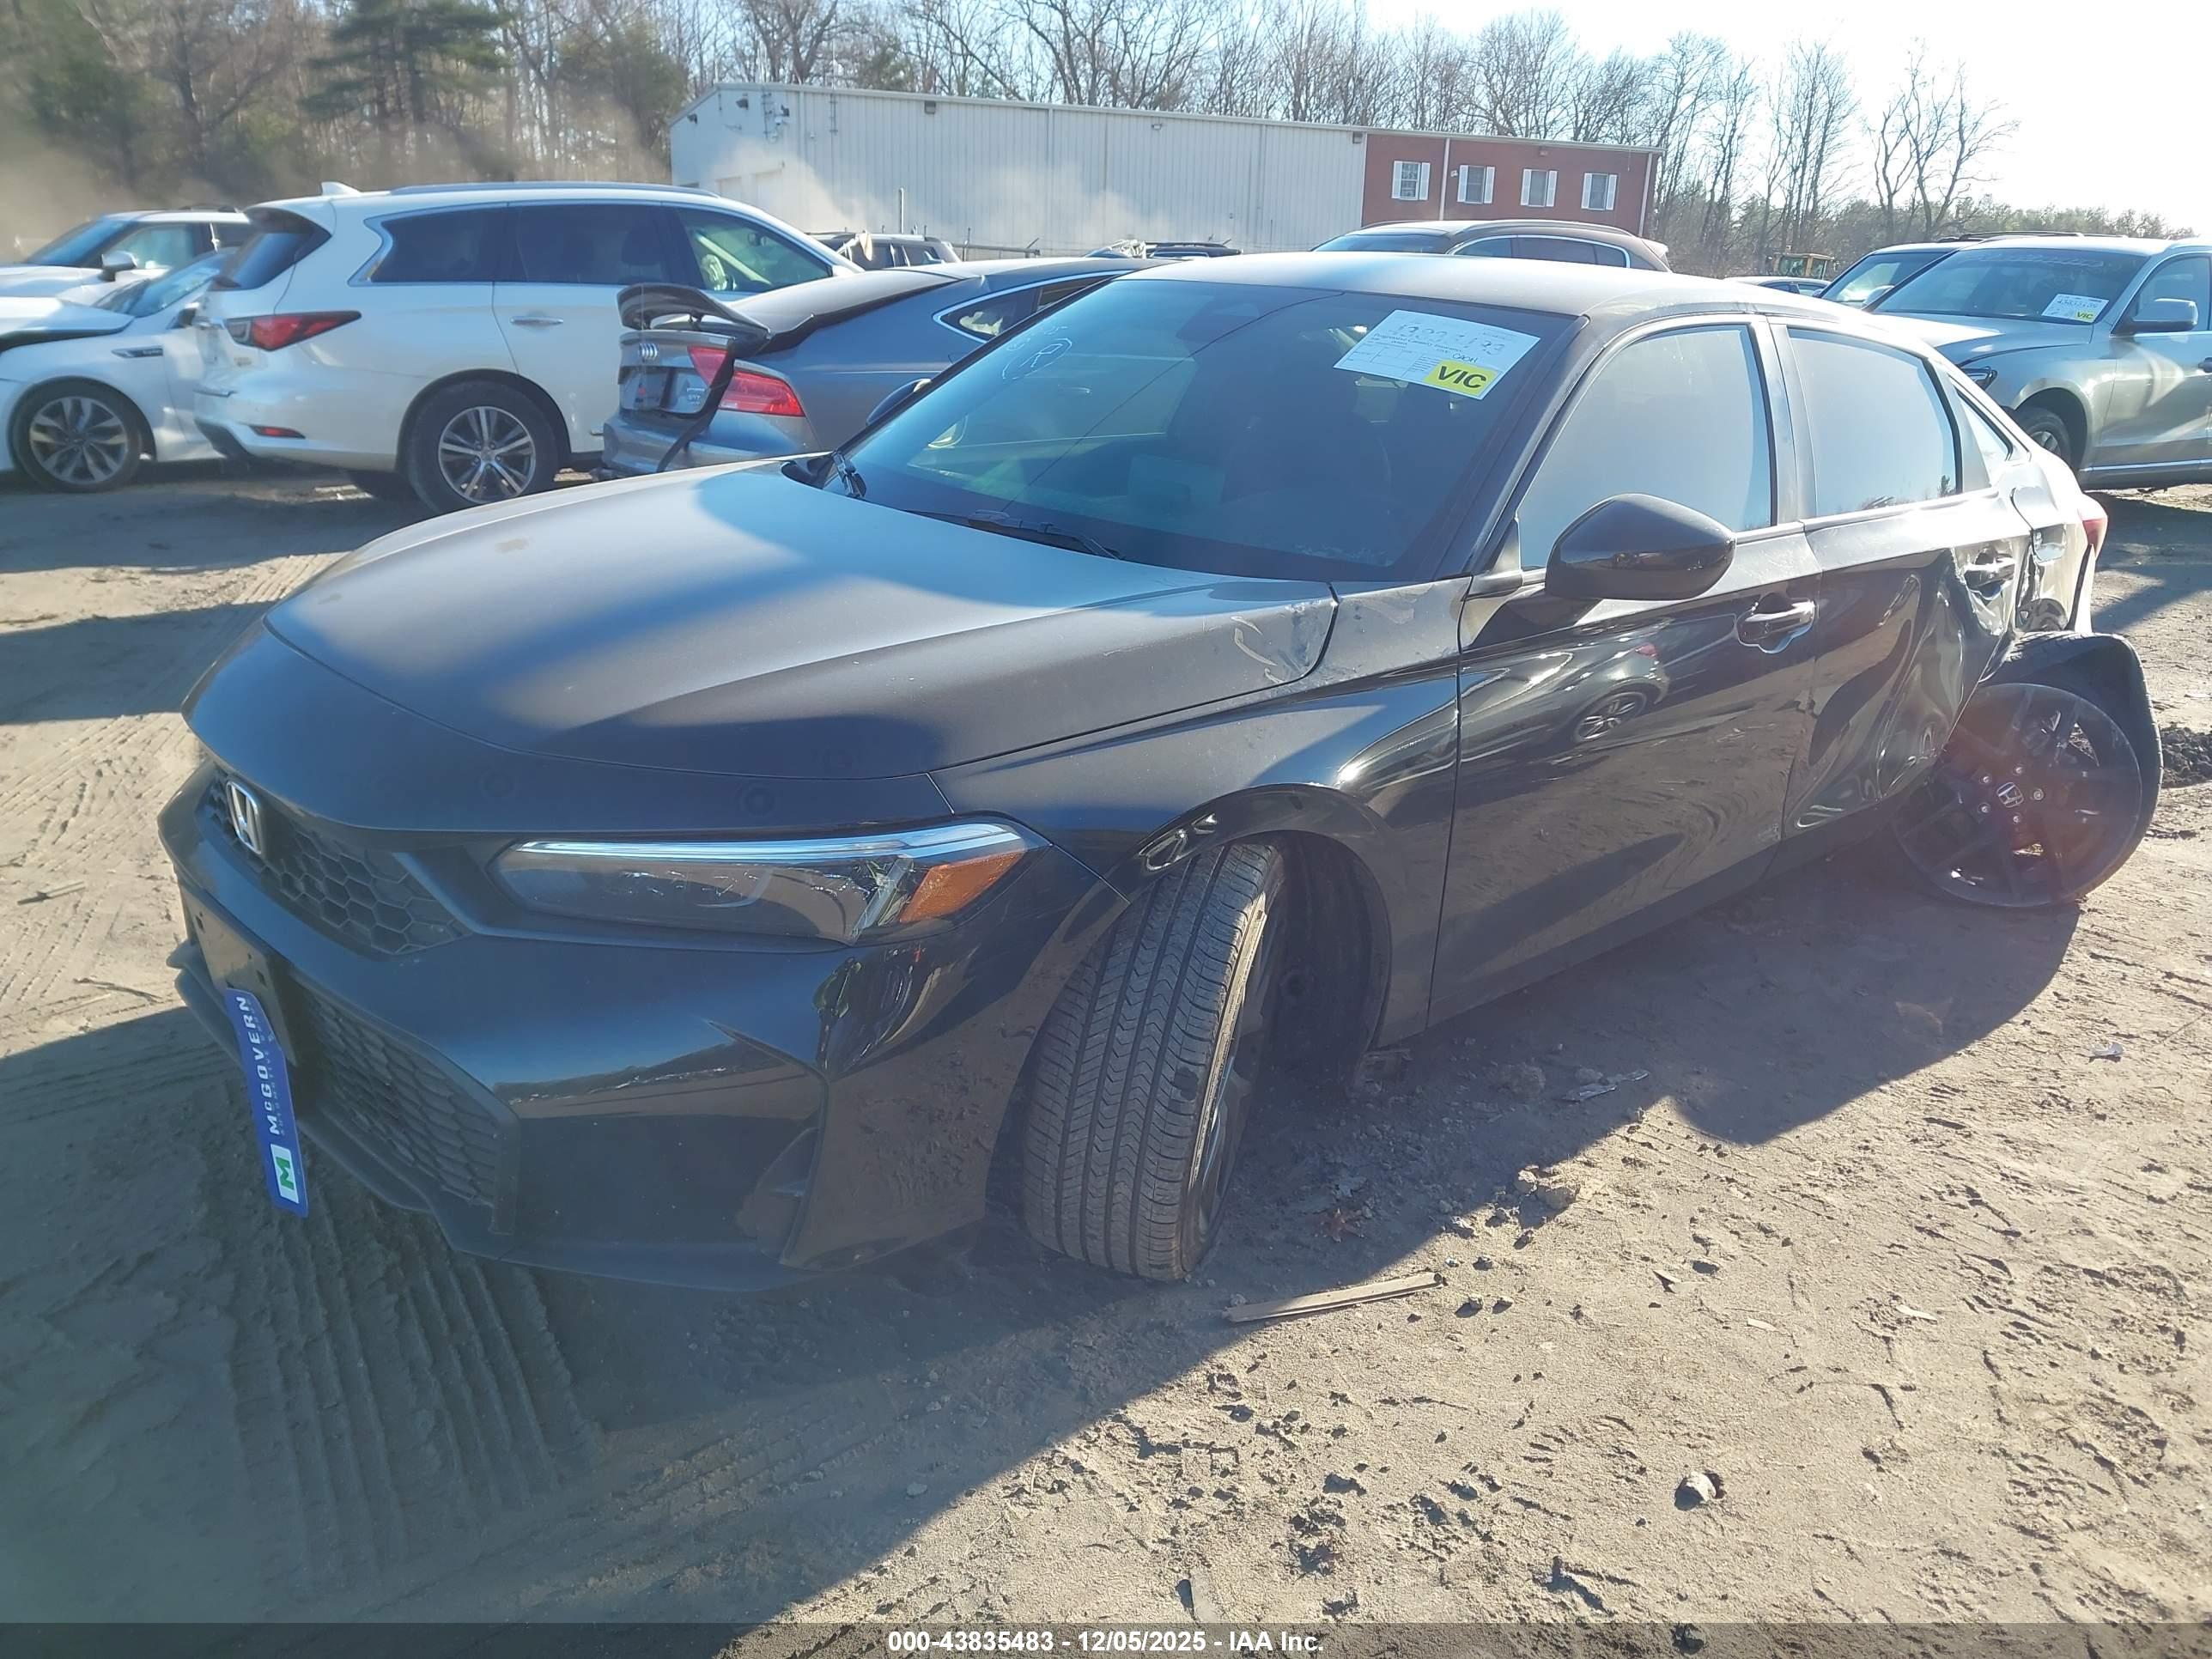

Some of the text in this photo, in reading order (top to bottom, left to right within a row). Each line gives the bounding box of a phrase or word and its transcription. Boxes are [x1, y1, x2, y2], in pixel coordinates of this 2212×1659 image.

[1438, 365, 1486, 388] VIC
[235, 996, 280, 1135] McGOVERN
[276, 1157, 295, 1190] M
